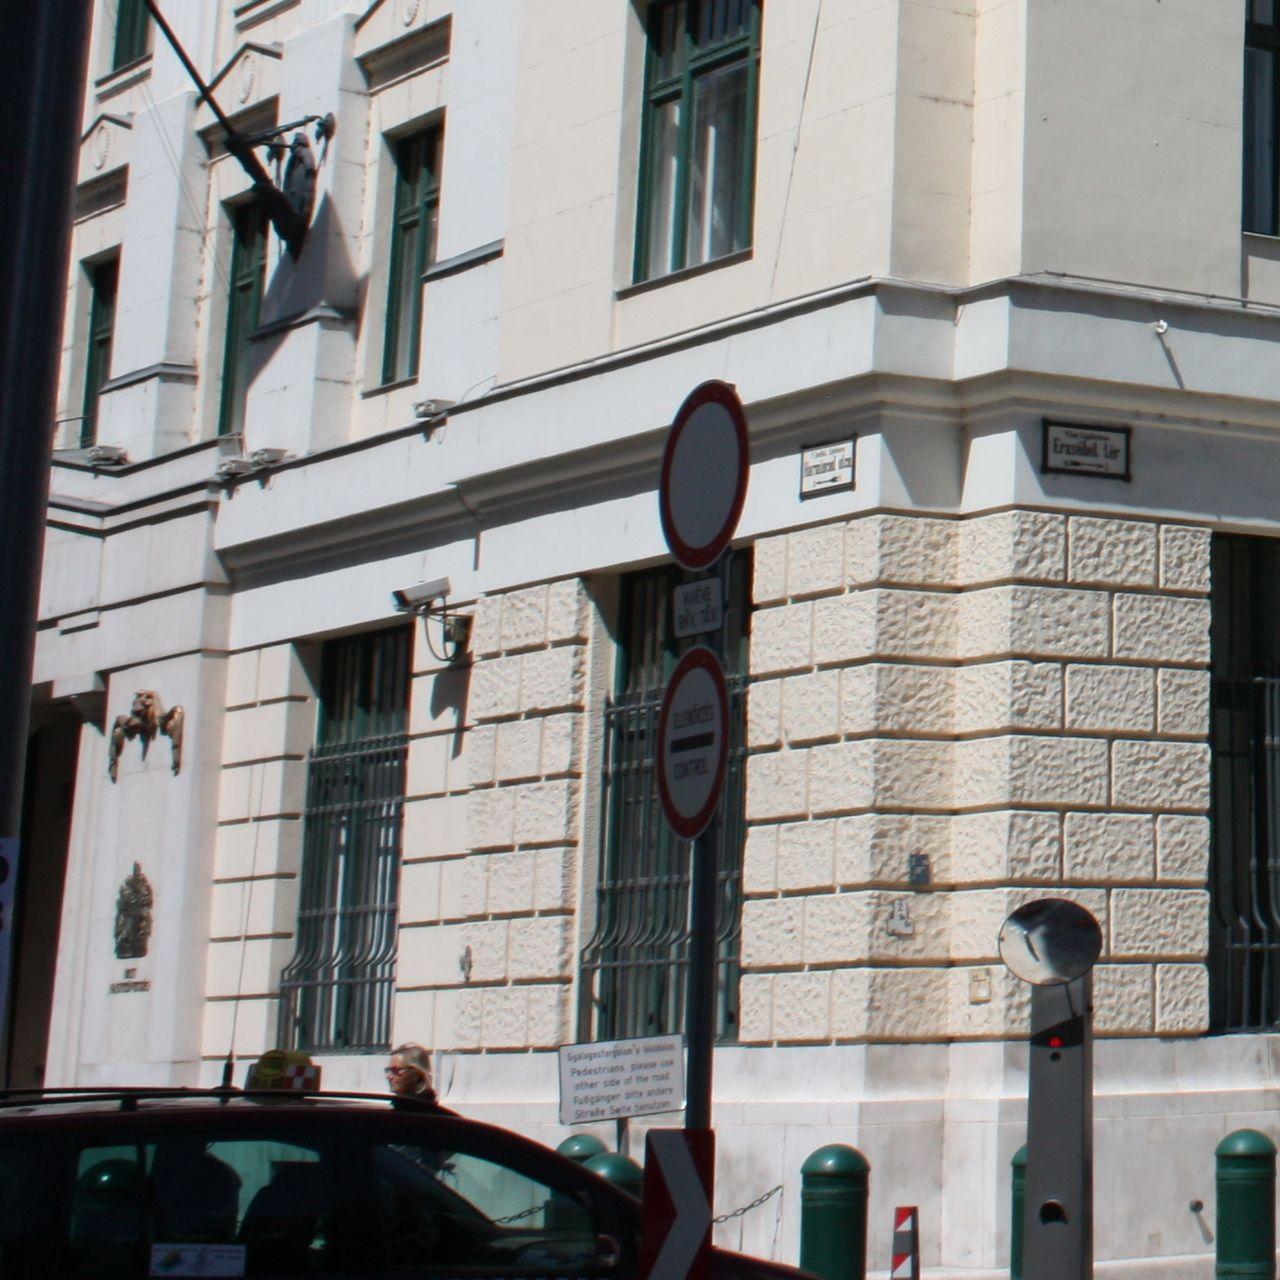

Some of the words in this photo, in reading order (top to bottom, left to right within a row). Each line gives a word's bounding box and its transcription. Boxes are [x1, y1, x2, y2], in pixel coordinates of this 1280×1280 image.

[631, 1061, 657, 1072] please
[660, 1059, 674, 1067] use
[575, 1078, 598, 1090] other
[604, 1077, 620, 1087] side
[624, 1076, 633, 1085] of
[635, 1074, 648, 1083] the
[647, 1086, 674, 1097] andere
